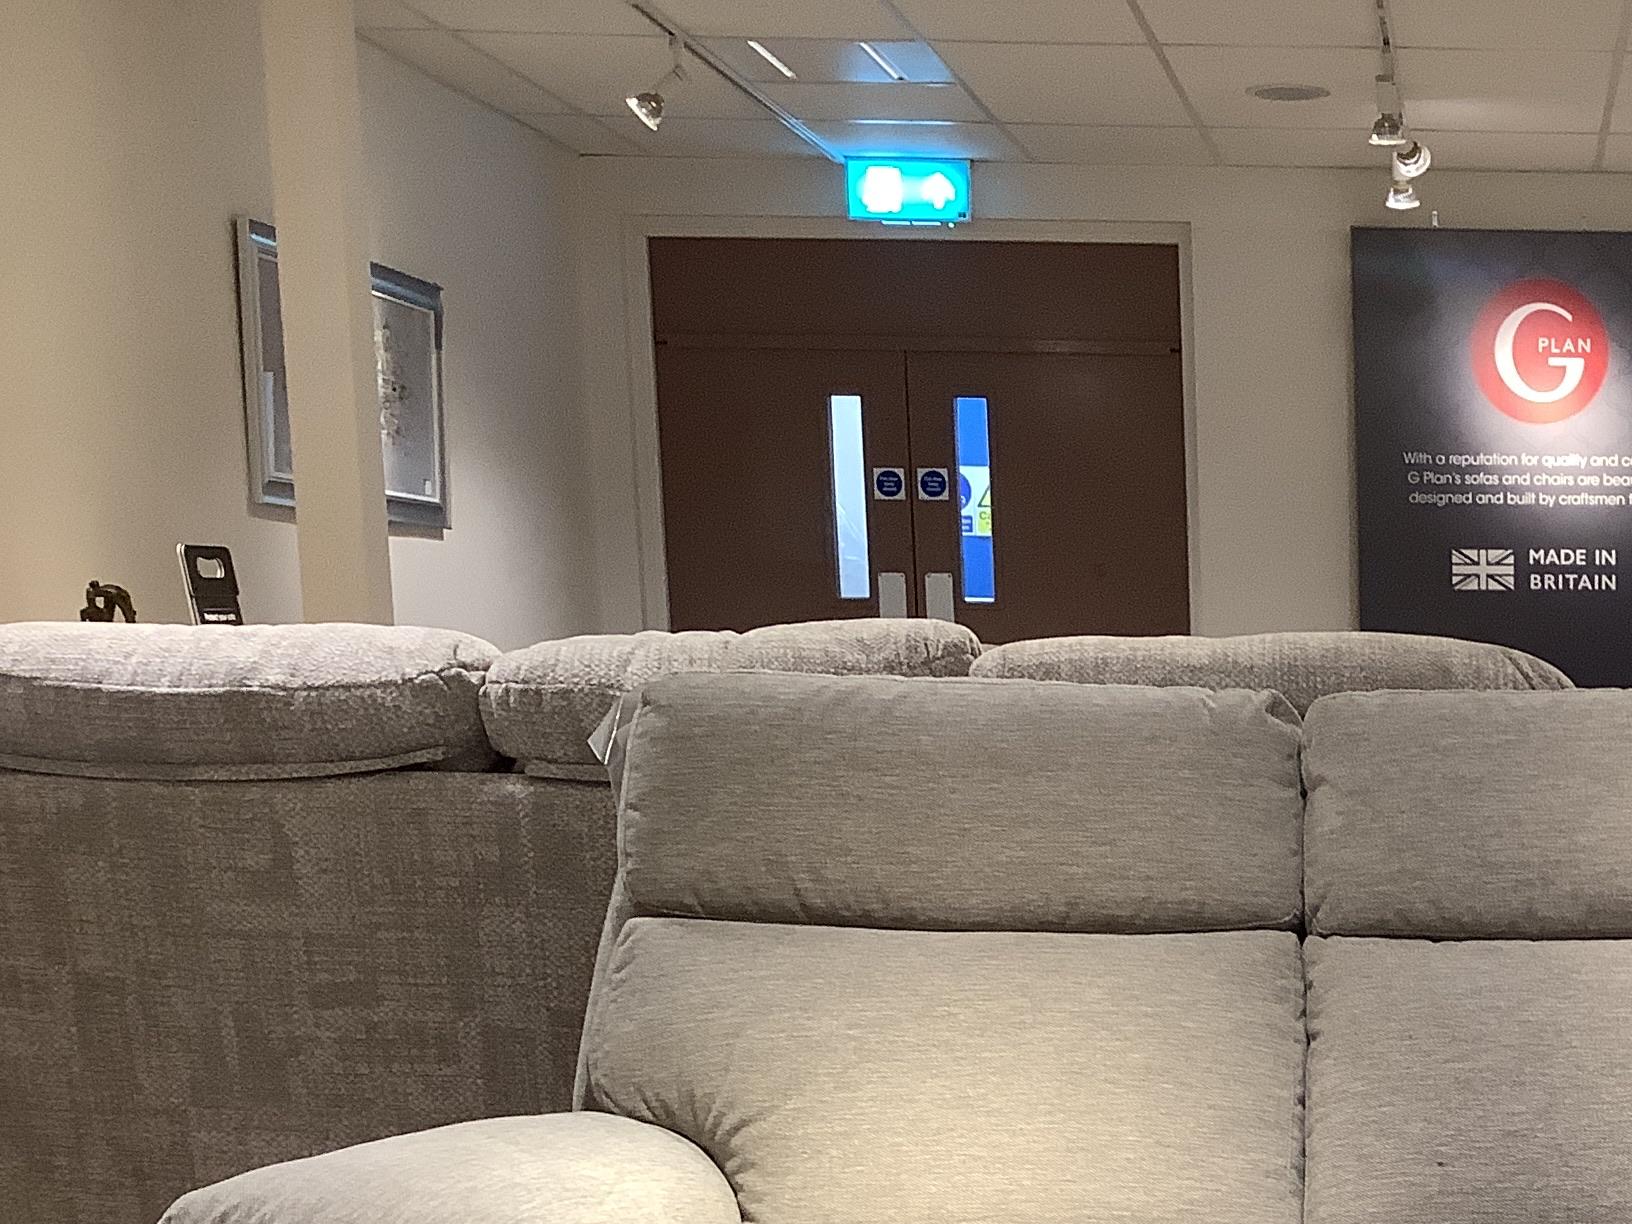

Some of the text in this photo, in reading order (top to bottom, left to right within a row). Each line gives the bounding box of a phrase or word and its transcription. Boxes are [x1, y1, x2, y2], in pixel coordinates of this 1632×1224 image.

[1494, 301, 1585, 403] G
[1538, 336, 1592, 354] PLAN
[1402, 452, 1433, 465] With
[1435, 454, 1446, 466] a
[1448, 453, 1519, 468] reputation
[1521, 453, 1540, 466] for
[1541, 453, 1588, 470] quality
[1589, 454, 1619, 467] and
[1407, 471, 1420, 485] G
[1423, 471, 1461, 485] Plan's
[1464, 472, 1500, 486] sofas
[1501, 473, 1531, 486] and
[1533, 473, 1575, 487] chairs
[1577, 474, 1601, 487] are
[1408, 491, 1473, 507] designed
[1475, 492, 1504, 505] and
[1507, 491, 1536, 505] built
[1538, 492, 1556, 508] by
[1558, 492, 1626, 506] craftsmen
[1528, 548, 1617, 566] MADE IN
[1529, 573, 1617, 591] BRITAIN
